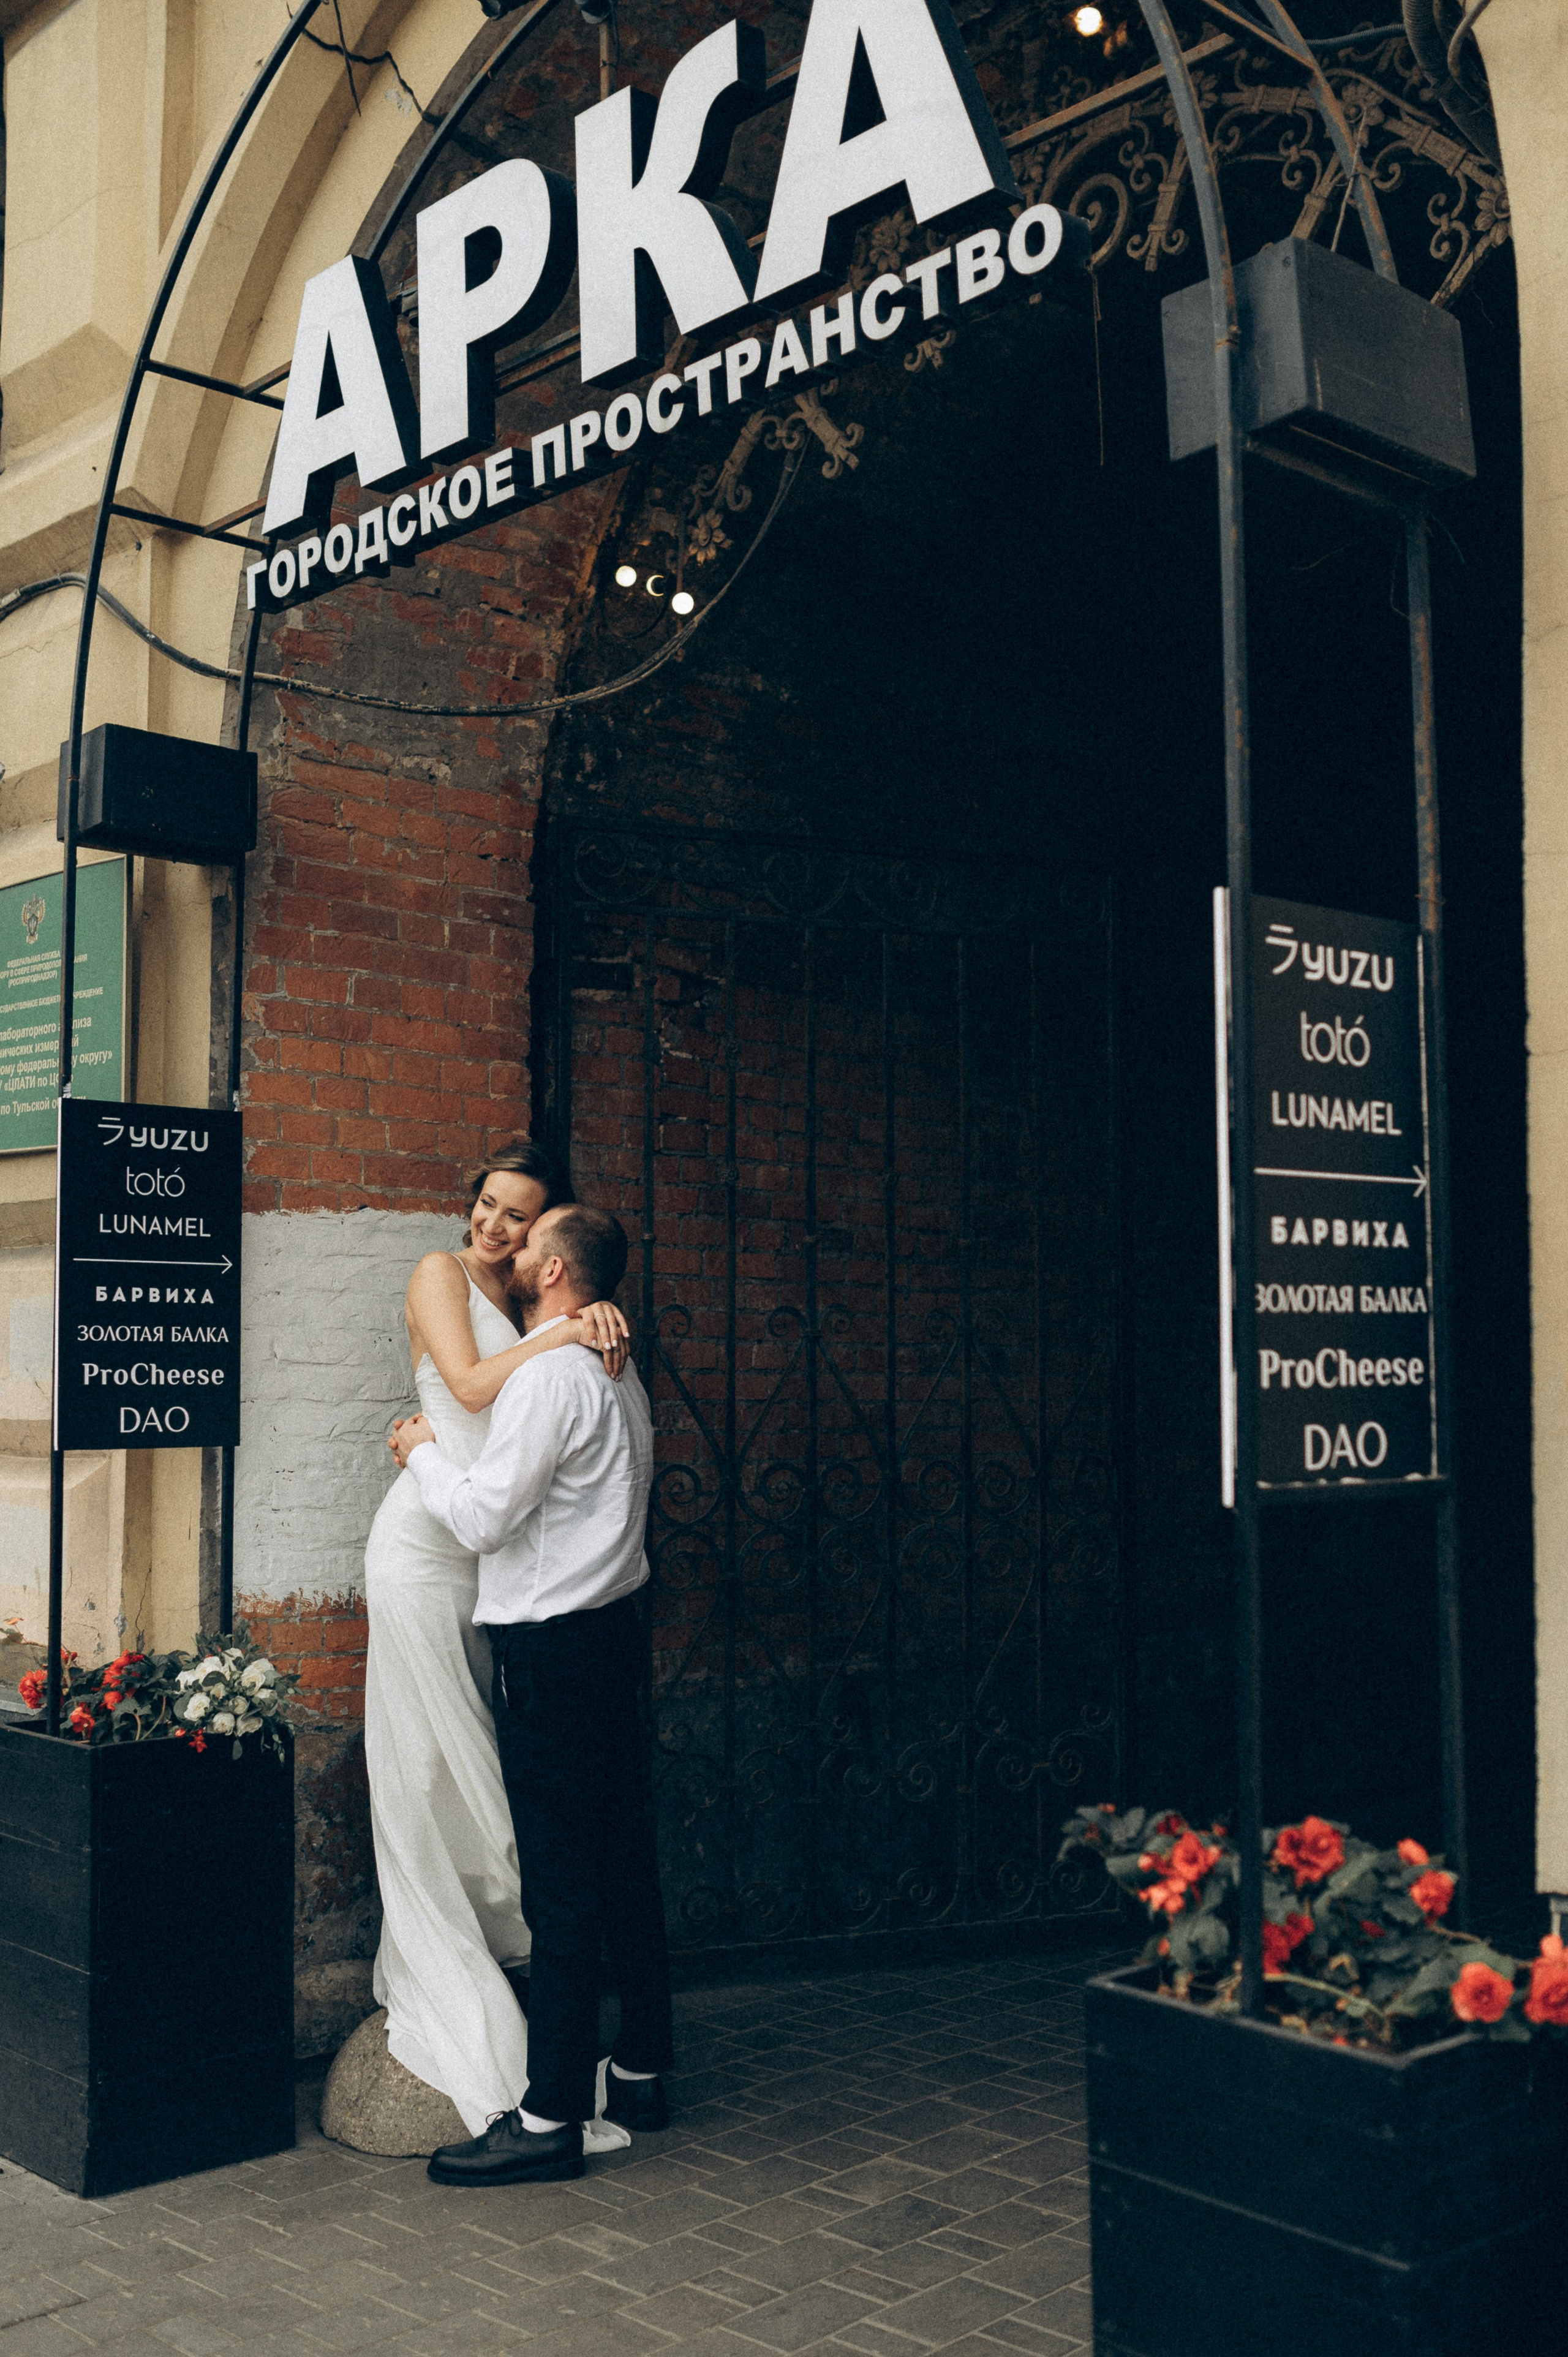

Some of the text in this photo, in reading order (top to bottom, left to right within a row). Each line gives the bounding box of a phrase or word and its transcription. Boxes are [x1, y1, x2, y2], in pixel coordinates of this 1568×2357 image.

[262, 0, 996, 536] АРКА
[246, 203, 1063, 610] ГОРОДСКОЕ ПРОСТРАНСТВО
[1272, 1091, 1402, 1136] LUNAMEL
[99, 1213, 211, 1237] LUNAMEL
[1271, 1216, 1409, 1248] БАРВИХА
[96, 1286, 214, 1304] БАРВИХА
[1255, 1283, 1427, 1313] ЗОЛОТАЯ БАЛКА
[77, 1325, 229, 1343] ЗОЛОТАЯ БАЛКА
[82, 1362, 224, 1386] ProCheese
[1259, 1348, 1424, 1389] ProCheese
[120, 1406, 190, 1433] DAO
[1304, 1421, 1387, 1471] DAO
